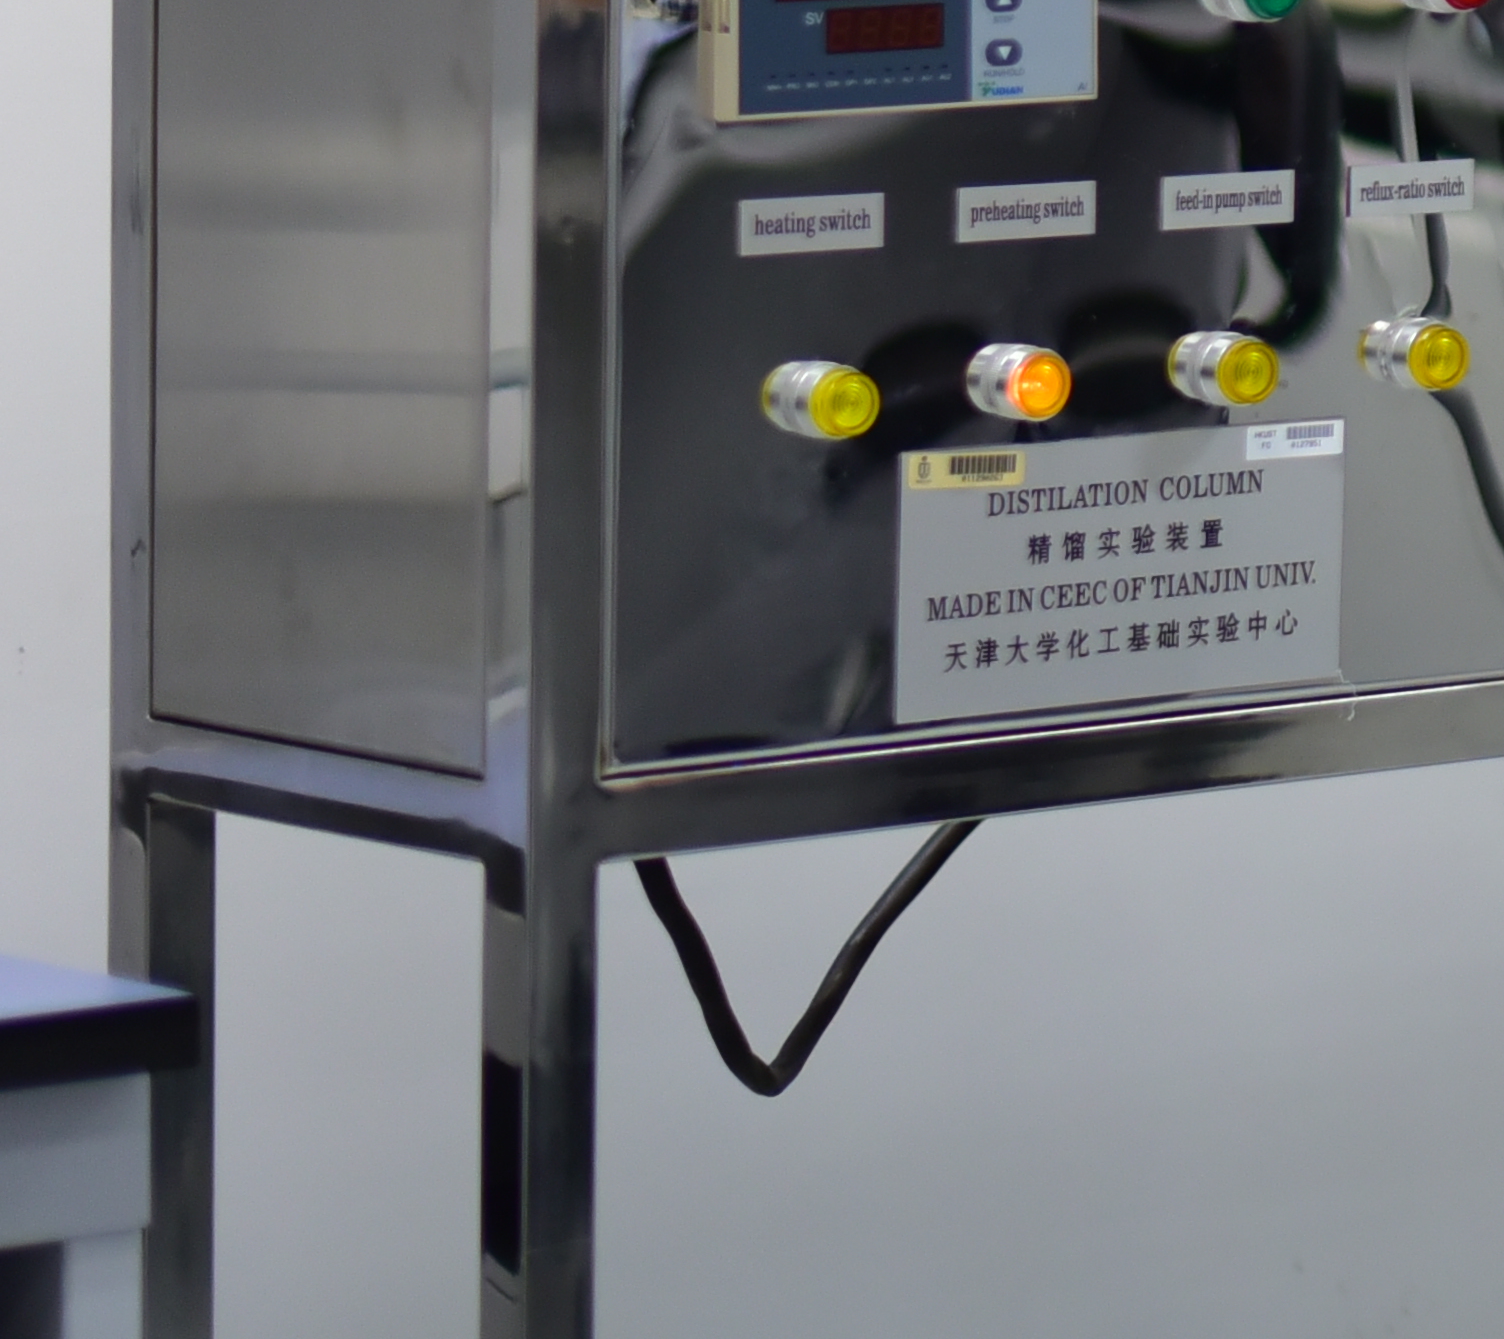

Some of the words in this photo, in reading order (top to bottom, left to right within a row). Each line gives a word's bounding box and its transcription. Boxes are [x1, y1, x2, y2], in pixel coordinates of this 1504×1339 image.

[805, 12, 824, 25] SV
[1175, 188, 1213, 212] feed-in
[1215, 192, 1246, 214] pump
[1247, 184, 1282, 207] switch
[1360, 178, 1425, 202] reflux-ratio
[1427, 175, 1465, 198] switch
[754, 211, 817, 238] heating
[819, 208, 871, 232] switch
[970, 198, 1042, 228] preheating
[1043, 195, 1085, 218] switch
[988, 478, 1150, 517] DISTILATION
[1159, 468, 1265, 504] COLUMN
[1027, 518, 1224, 565] 精馏实验装置
[926, 591, 1001, 622] MADE
[1006, 586, 1036, 614] IN
[1040, 580, 1108, 611] CEEC
[1112, 576, 1147, 605] OF
[1151, 566, 1249, 600] TIANJIN
[942, 607, 1300, 674] 天津大学化工基础实验中心
